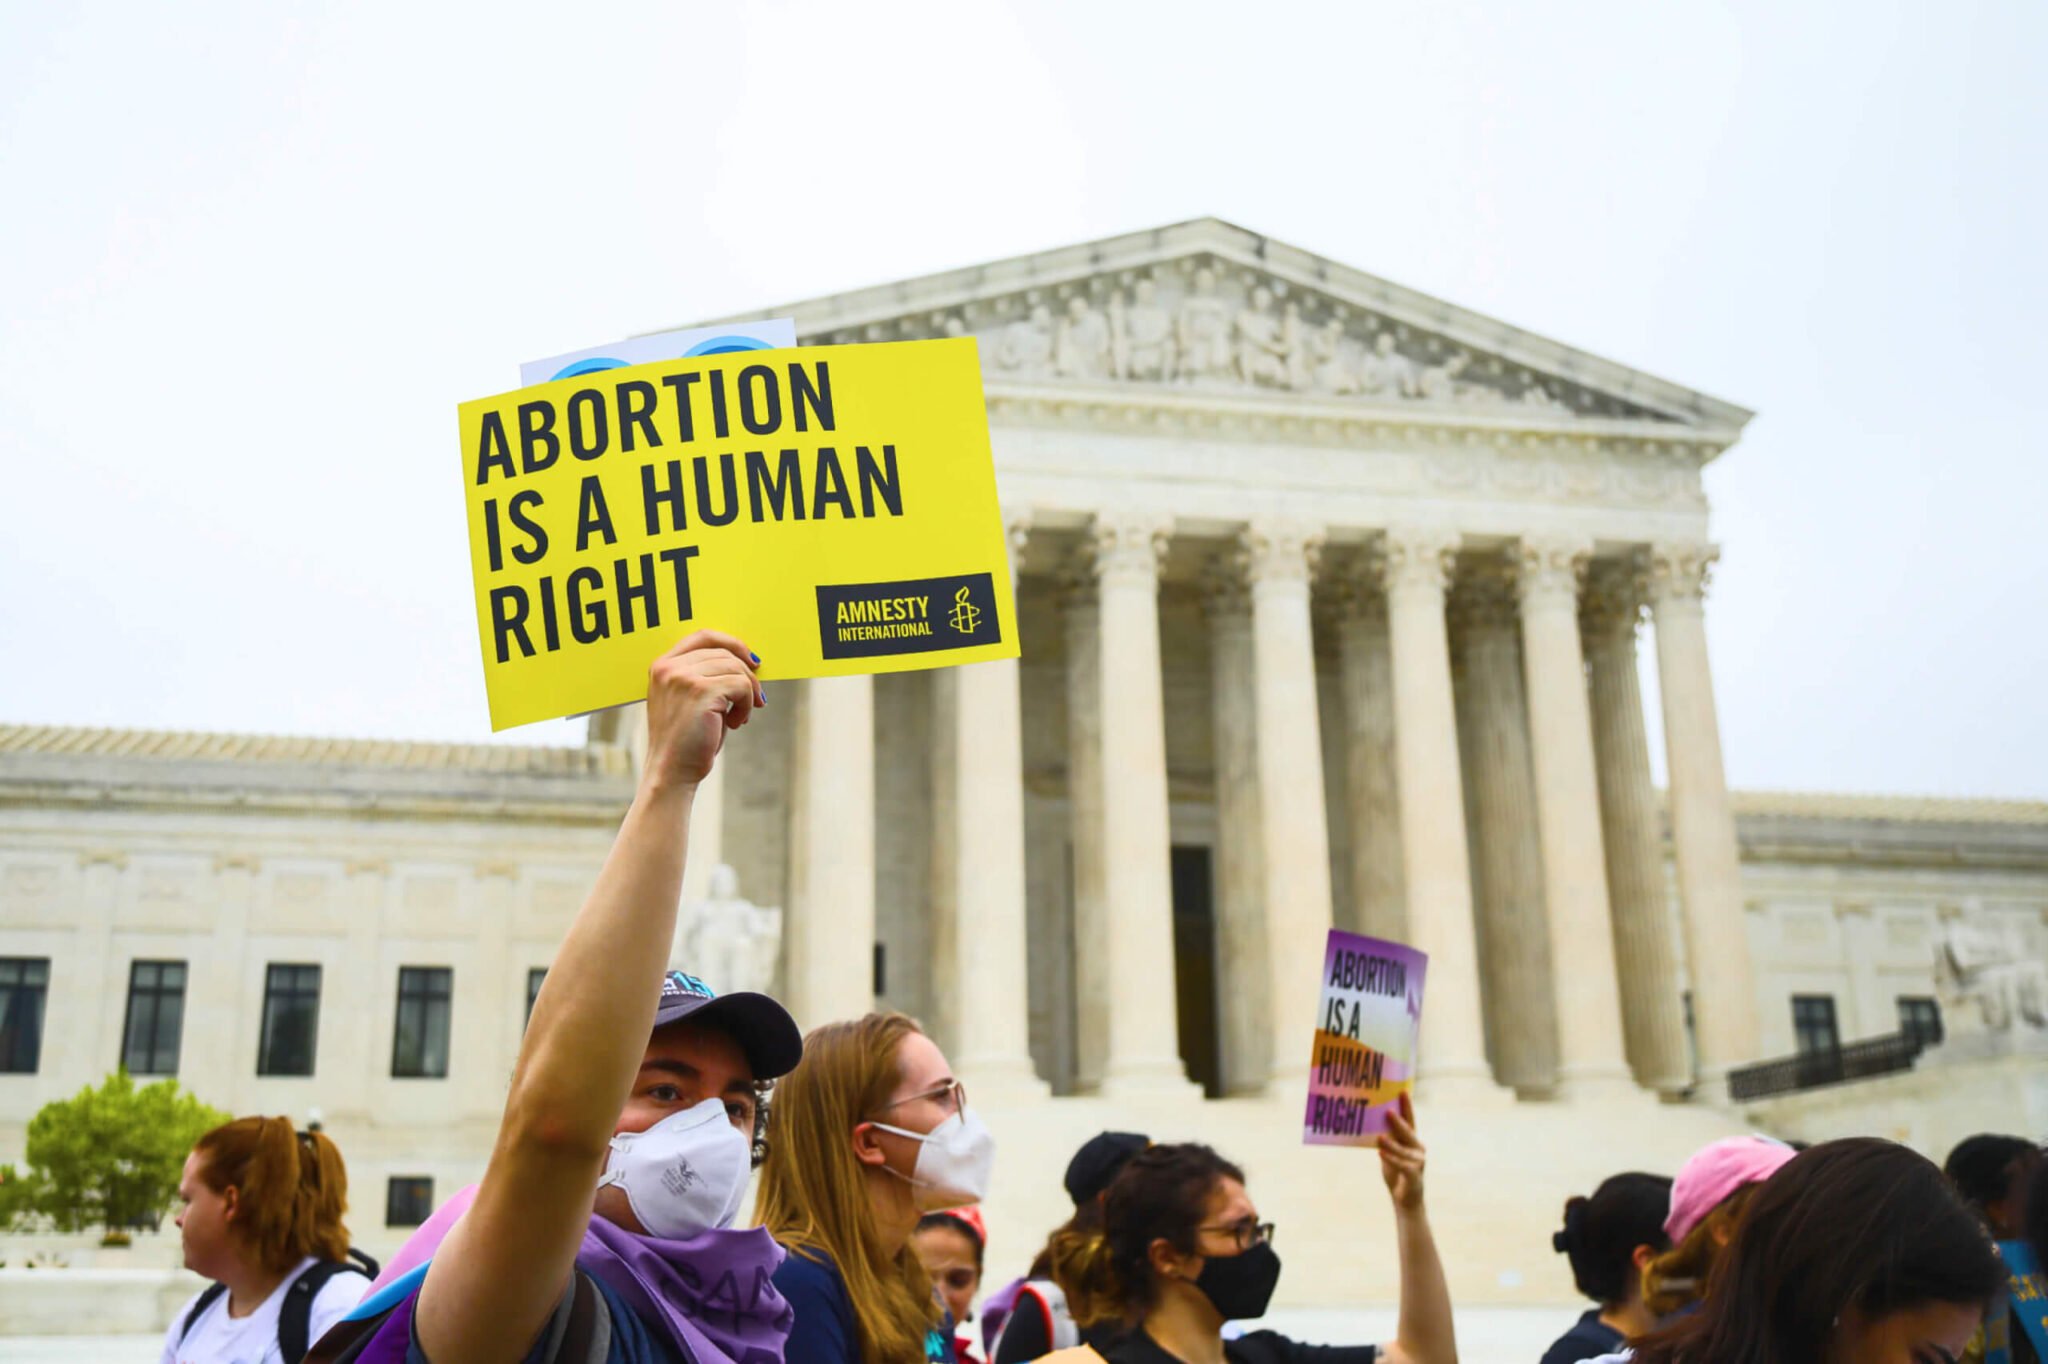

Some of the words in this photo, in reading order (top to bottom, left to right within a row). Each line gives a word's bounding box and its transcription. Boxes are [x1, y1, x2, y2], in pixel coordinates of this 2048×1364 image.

[476, 361, 836, 486] ABORTION
[484, 489, 549, 572] IS
[575, 475, 618, 552] A
[640, 444, 904, 536] HUMAN
[489, 545, 700, 664] RIGHT
[836, 595, 929, 625] AMNESTY
[837, 621, 933, 642] INTERNATIONAL
[1330, 950, 1406, 997] ABORTION
[1325, 998, 1345, 1036] IS
[1348, 1001, 1361, 1040] A
[1319, 1046, 1384, 1089] HUMAN
[1312, 1095, 1368, 1136] RIGHT
